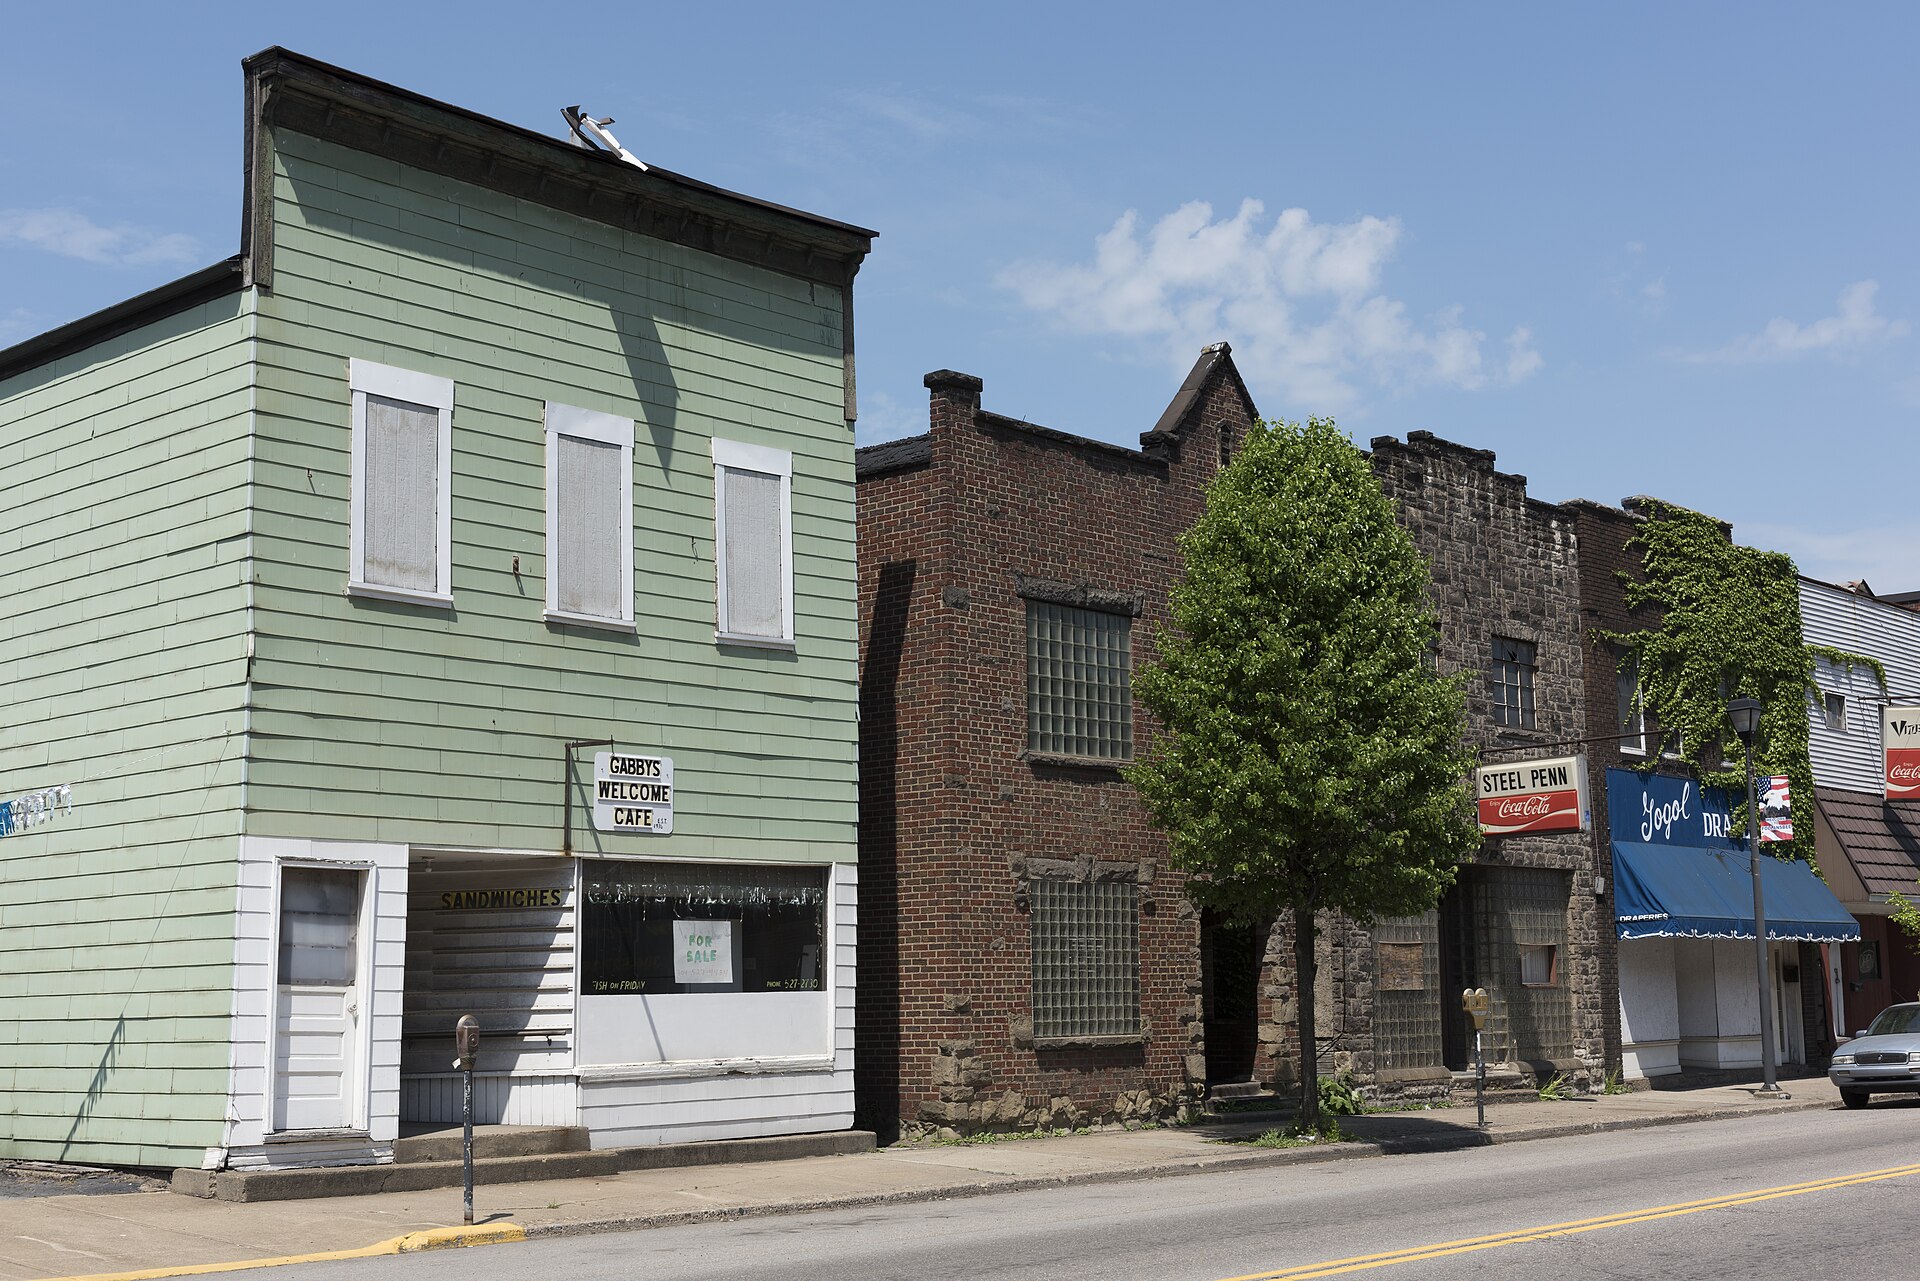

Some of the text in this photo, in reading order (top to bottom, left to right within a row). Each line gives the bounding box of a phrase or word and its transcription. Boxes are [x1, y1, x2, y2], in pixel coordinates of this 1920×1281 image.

[610, 756, 660, 776] GABBYS
[1483, 766, 1568, 792] STEEL PENN
[599, 780, 670, 802] WELCOME
[1498, 795, 1552, 818] Coca-Cola
[614, 807, 652, 826] CAFE
[441, 889, 561, 909] SANDWICHES
[1619, 913, 1669, 922] DRAPERIES
[688, 934, 713, 947] FOR
[686, 949, 717, 963] SALE
[620, 980, 646, 990] FRIDAY
